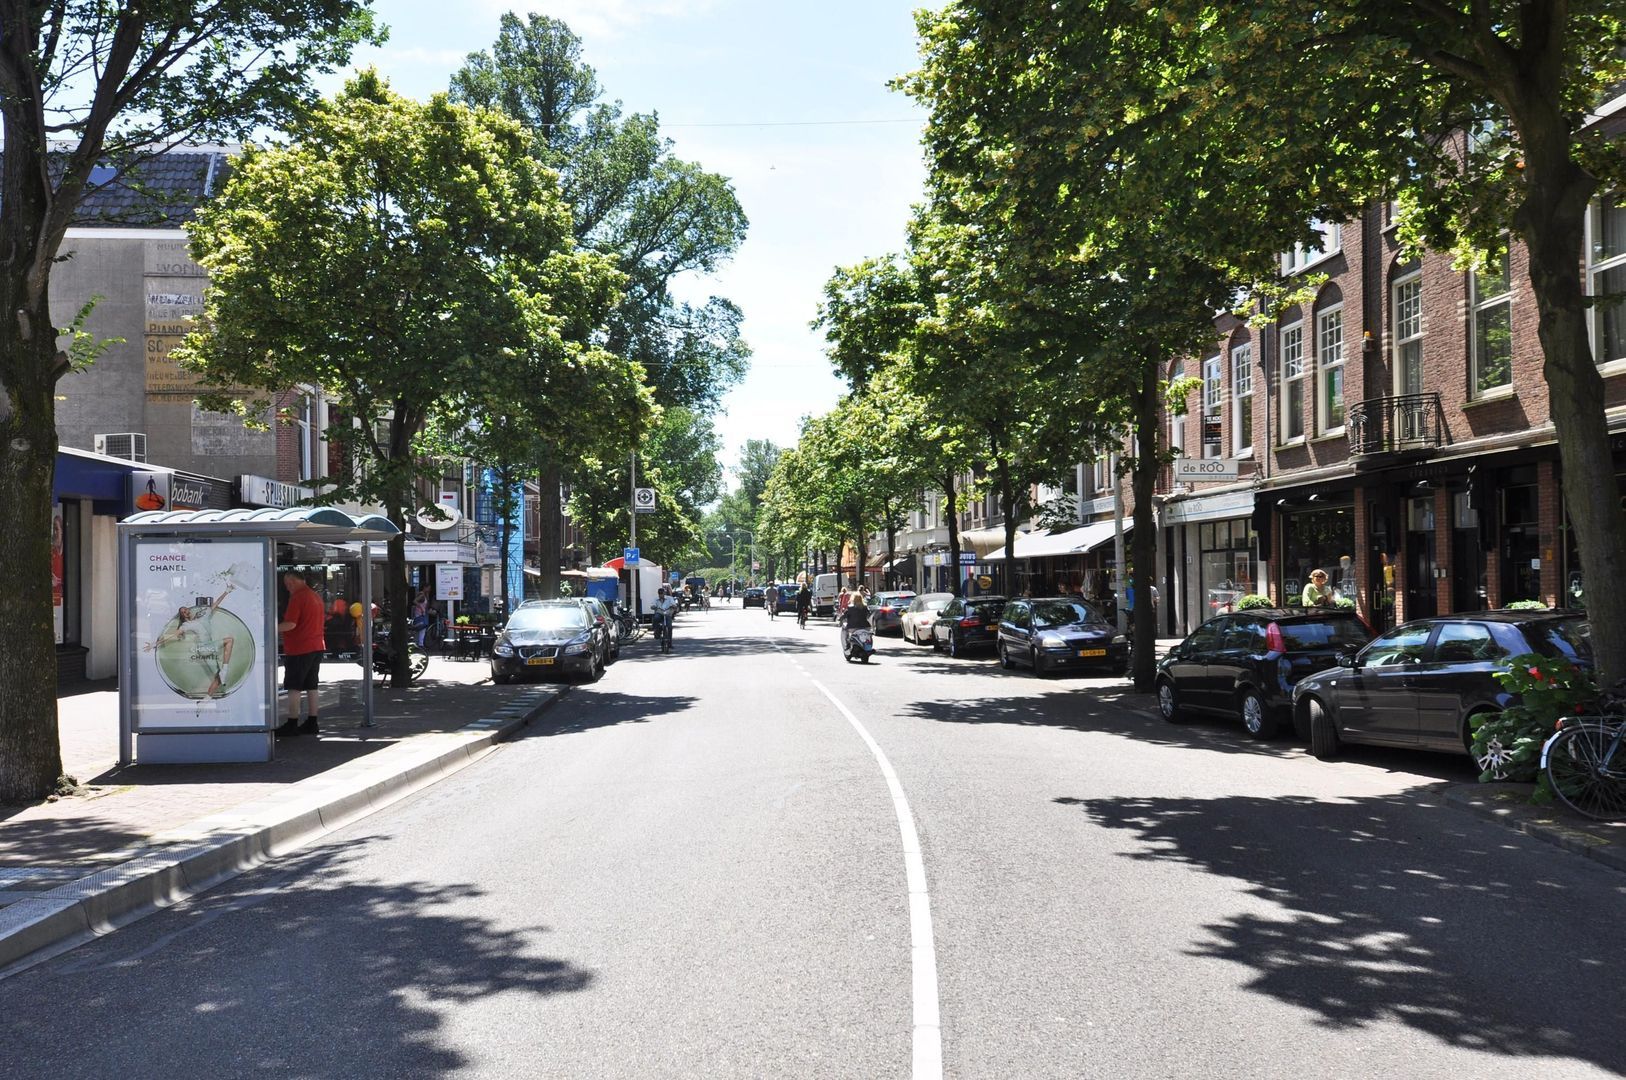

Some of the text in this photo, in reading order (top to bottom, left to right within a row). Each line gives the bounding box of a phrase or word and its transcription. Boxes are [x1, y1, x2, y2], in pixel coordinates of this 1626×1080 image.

[1183, 463, 1225, 473] de ROO
[1285, 580, 1299, 595] sale
